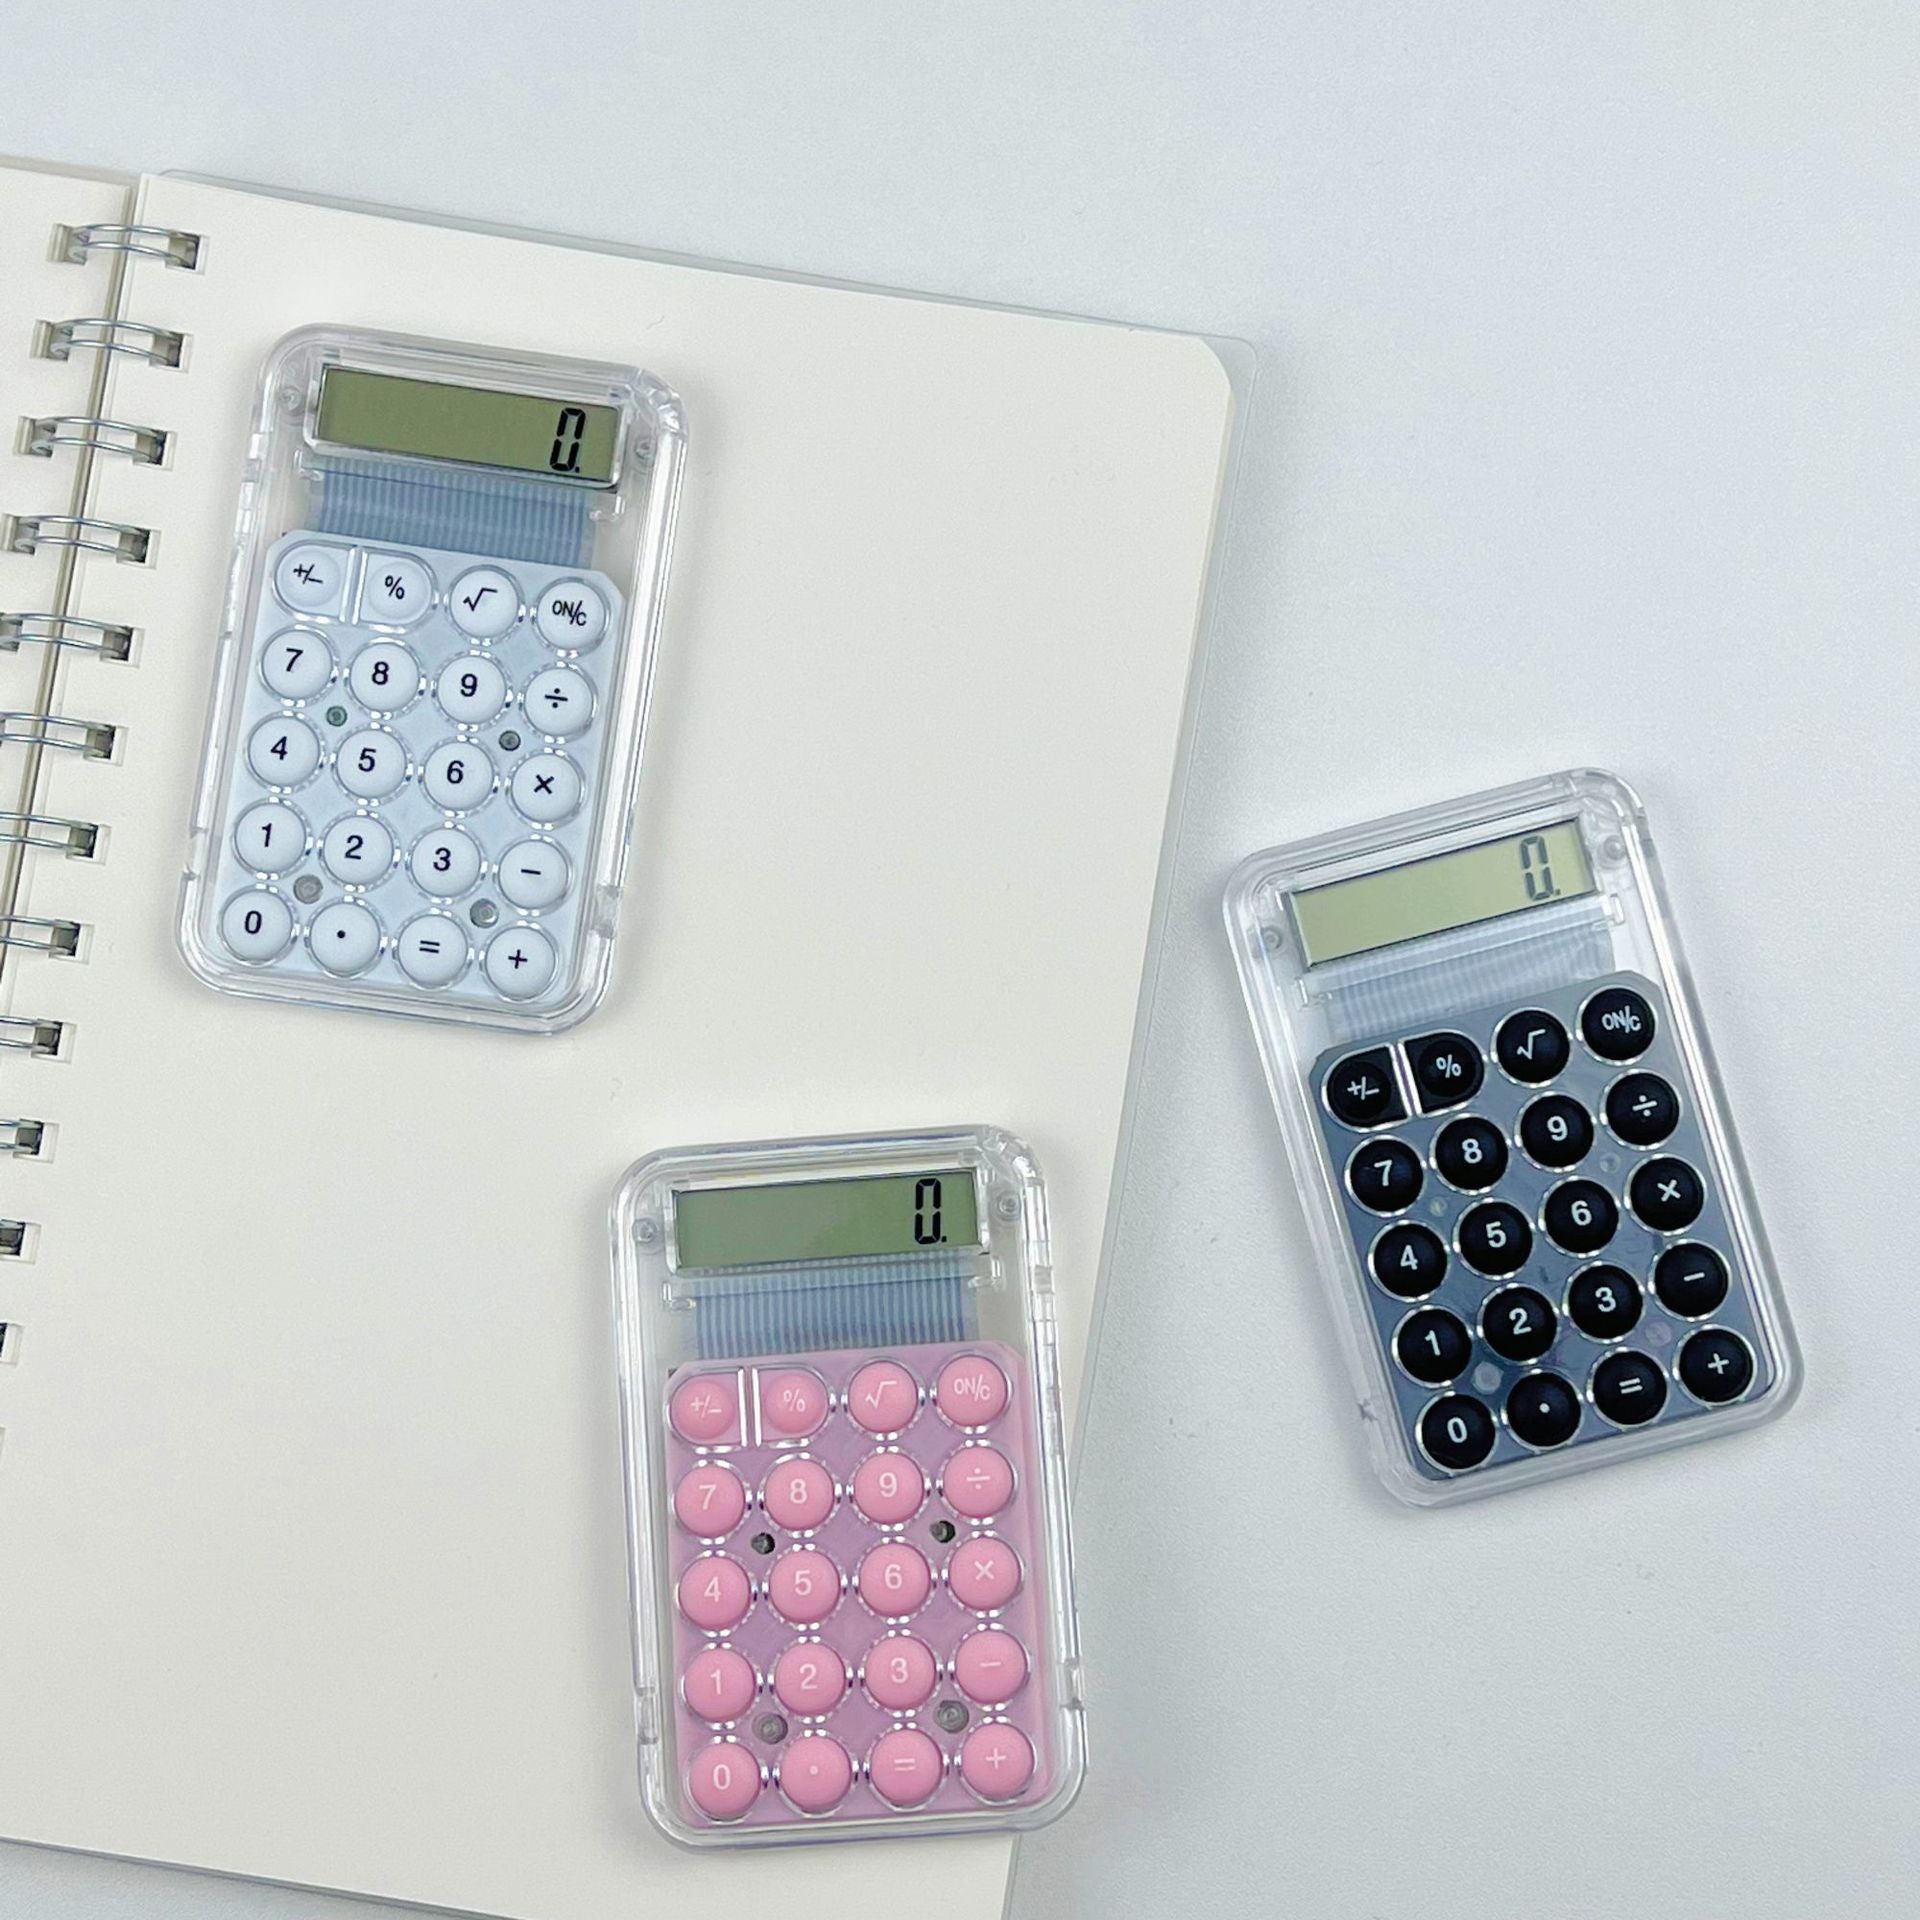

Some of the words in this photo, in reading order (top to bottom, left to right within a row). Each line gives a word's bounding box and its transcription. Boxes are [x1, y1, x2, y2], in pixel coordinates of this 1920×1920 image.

[552, 600, 586, 626] ON/C
[286, 648, 303, 672] 7
[372, 662, 389, 685] 8
[461, 674, 477, 697] 9
[271, 736, 287, 760] 4
[358, 748, 376, 772] 5
[447, 760, 464, 784] 6
[262, 823, 272, 847] 1
[345, 835, 363, 859] 2
[434, 848, 451, 871] 3
[245, 911, 262, 934] 0
[1602, 1006, 1641, 1033] ON/C
[1374, 1160, 1392, 1186] 7
[1462, 1139, 1482, 1163] 8
[1548, 1116, 1567, 1141] 9
[1401, 1245, 1418, 1269] 4
[1486, 1221, 1506, 1247] 5
[1572, 1201, 1591, 1225] 6
[1425, 1330, 1440, 1355] 1
[1509, 1308, 1531, 1334] 2
[1596, 1287, 1616, 1312] 3
[954, 1374, 990, 1401] ON/C
[1448, 1418, 1467, 1442] 0
[699, 1484, 716, 1510] 7
[790, 1479, 807, 1504] 8
[879, 1472, 897, 1497] 9
[704, 1577, 721, 1602] 4
[795, 1570, 811, 1595] 5
[885, 1564, 902, 1589] 6
[711, 1669, 721, 1694] 1
[800, 1664, 817, 1689] 2
[891, 1658, 908, 1683] 3
[713, 1764, 730, 1790] 0
